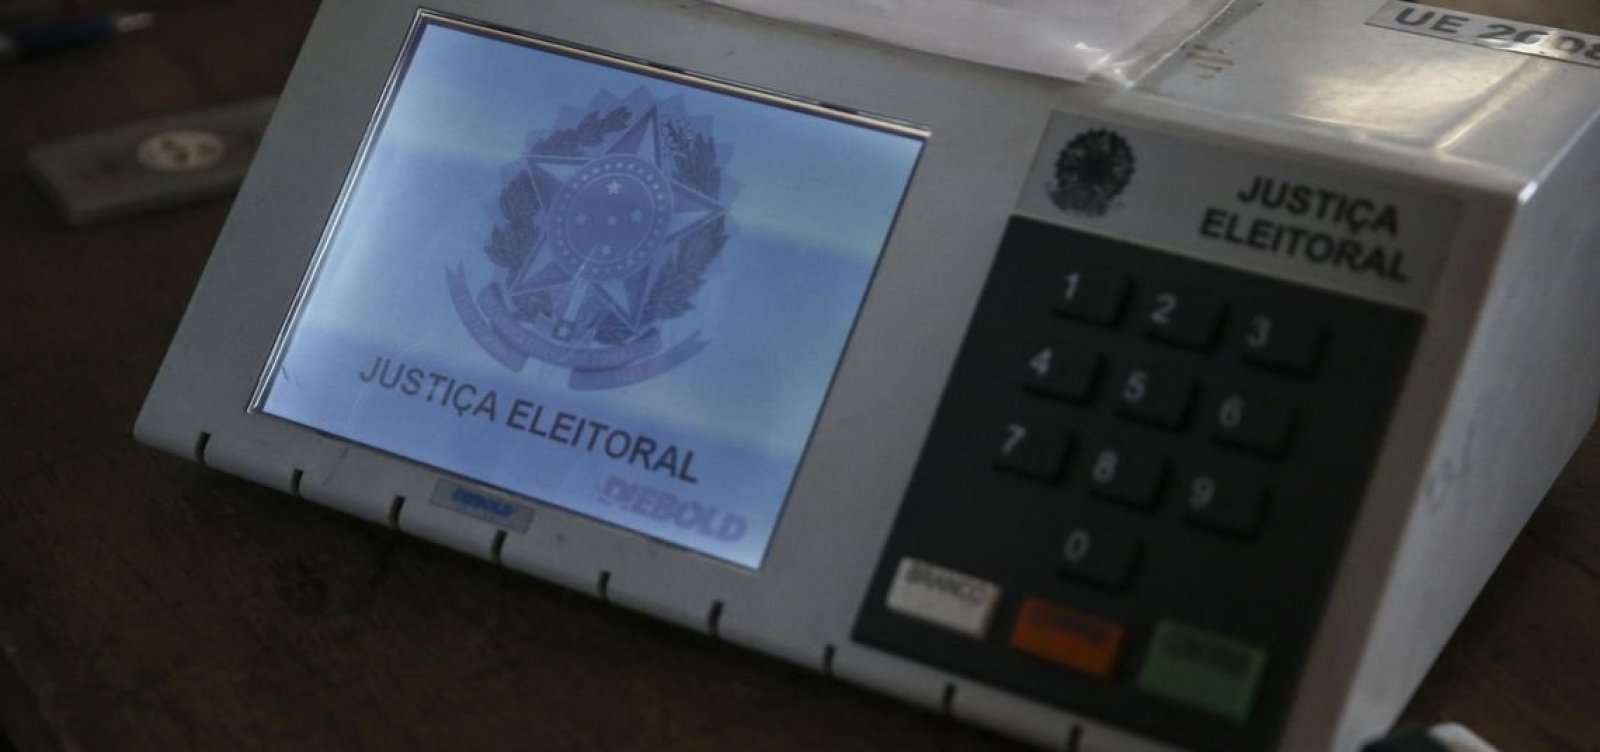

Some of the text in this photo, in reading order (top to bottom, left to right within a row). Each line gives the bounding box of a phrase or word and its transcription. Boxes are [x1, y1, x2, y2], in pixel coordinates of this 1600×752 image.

[1394, 6, 1470, 34] UE
[1236, 174, 1398, 237] JUSTIÇA
[1200, 207, 1411, 284] ELEITORAL
[1064, 272, 1081, 300] 1
[1150, 292, 1178, 325] 2
[1246, 315, 1272, 348] 3
[1028, 347, 1053, 377] 4
[1122, 370, 1147, 402] 5
[358, 356, 699, 483] JUSTIÇA ELEITORAL
[1218, 395, 1245, 429] 6
[1002, 423, 1028, 454] 7
[1092, 450, 1118, 483] 8
[600, 474, 748, 543] DIEBOLD
[1190, 475, 1216, 510] 9
[1063, 528, 1091, 563] 0
